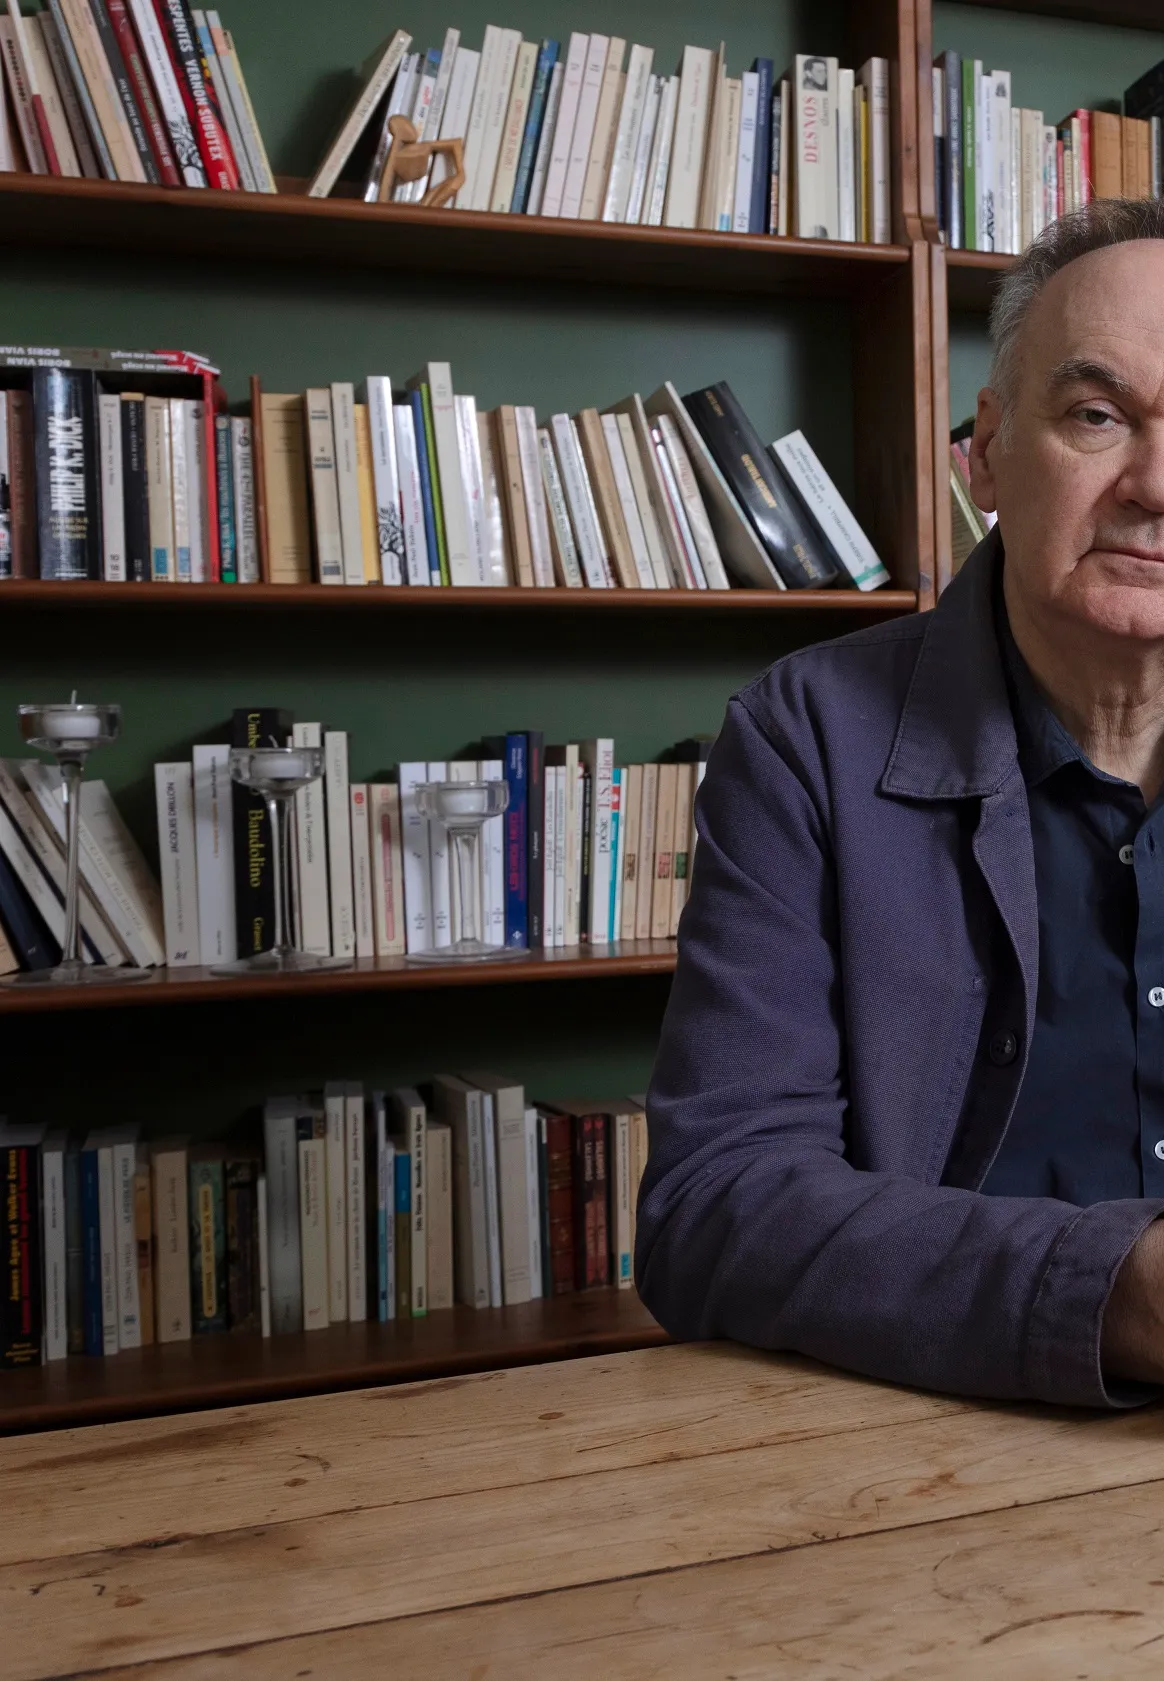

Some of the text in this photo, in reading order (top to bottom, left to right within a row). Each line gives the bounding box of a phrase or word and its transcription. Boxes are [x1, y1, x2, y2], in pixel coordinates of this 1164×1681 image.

[166, 0, 194, 54] ESPENTES
[183, 57, 209, 107] VERNON
[196, 103, 224, 162] SUBUTEX
[803, 95, 820, 163] DESNOS
[6, 355, 72, 368] BORIS VIAN
[28, 346, 61, 357] BORIS
[46, 415, 83, 451] DICK
[48, 452, 84, 469] K.
[48, 467, 86, 512] PHILIP
[167, 781, 179, 854] JACQUES DRILLON
[247, 807, 263, 888] Baudolino
[6, 1148, 17, 1181] Evans
